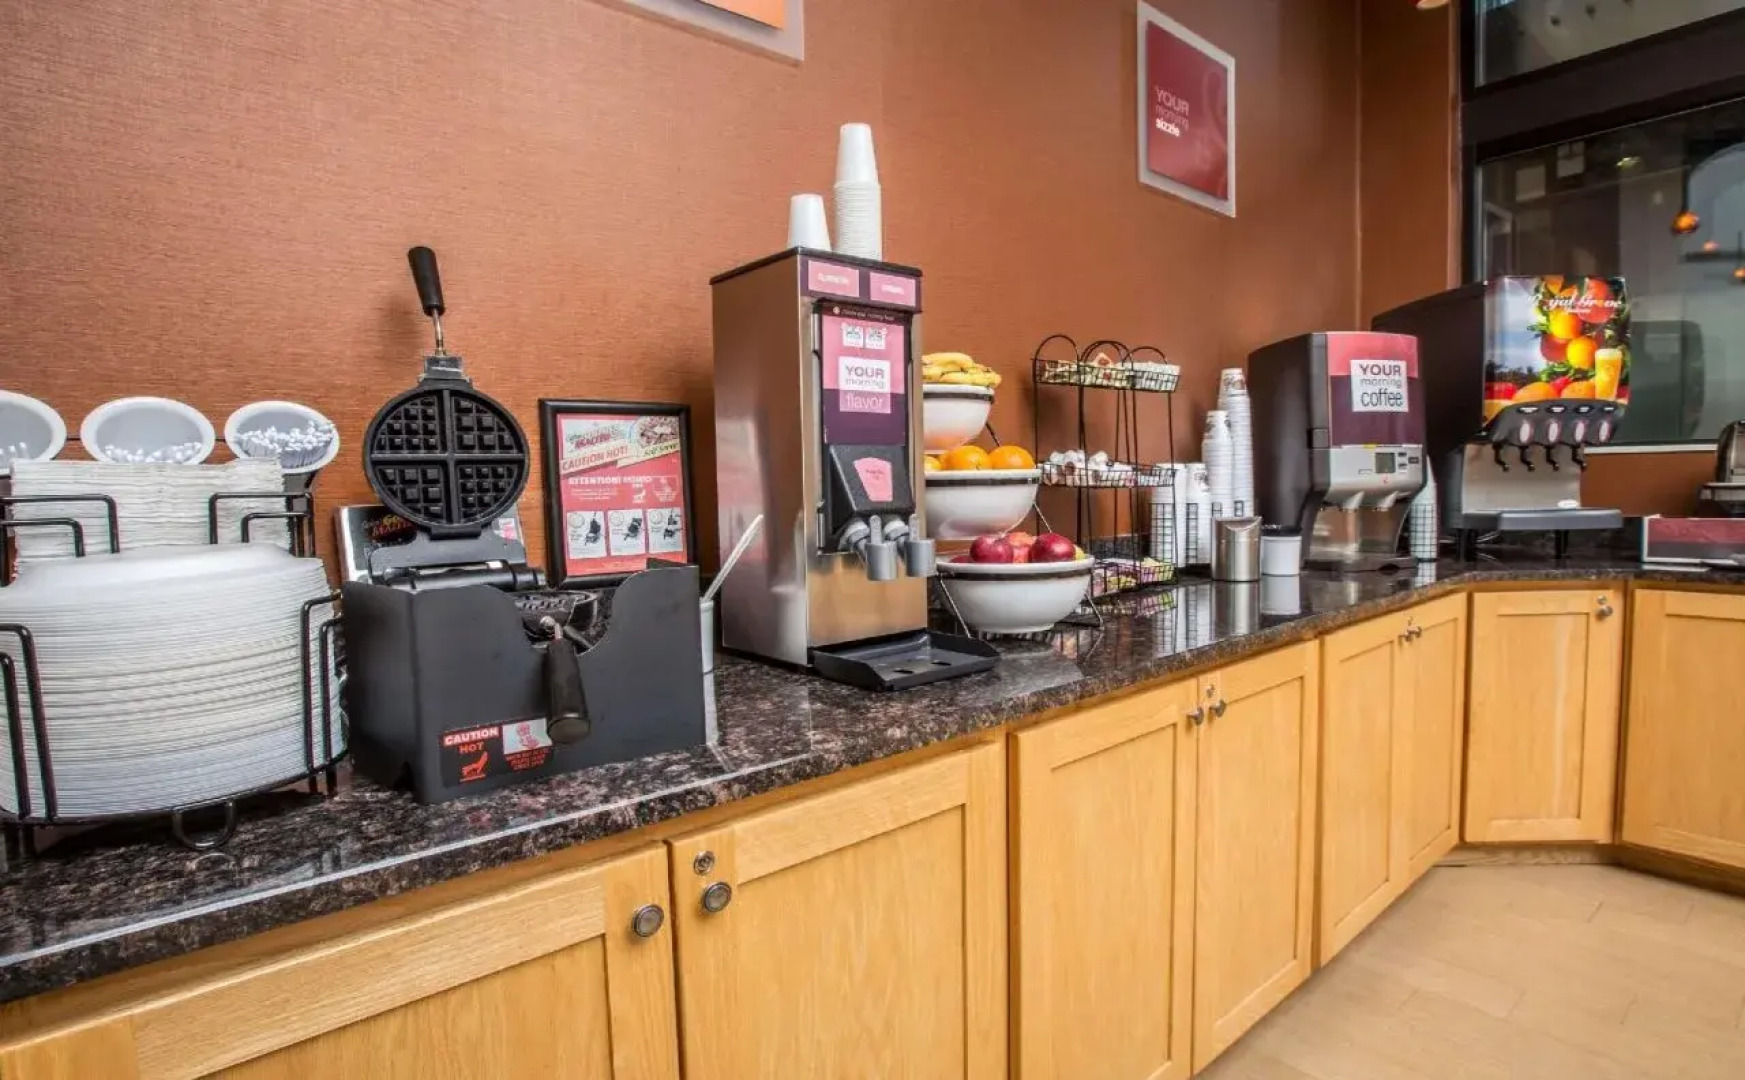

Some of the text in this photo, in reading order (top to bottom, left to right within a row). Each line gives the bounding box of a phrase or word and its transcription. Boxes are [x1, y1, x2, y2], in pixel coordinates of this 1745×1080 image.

[1155, 86, 1189, 116] YOUR
[1156, 118, 1180, 136] sizzle
[845, 365, 885, 379] YOUR
[1360, 364, 1401, 376] YOUR
[845, 379, 885, 389] morning
[1361, 378, 1402, 388] morning
[845, 393, 885, 410] flavor
[1361, 388, 1403, 407] coffee
[562, 446, 628, 471] CAUTION HOT!
[445, 728, 498, 746] CAUTION
[459, 741, 484, 753] HOT
